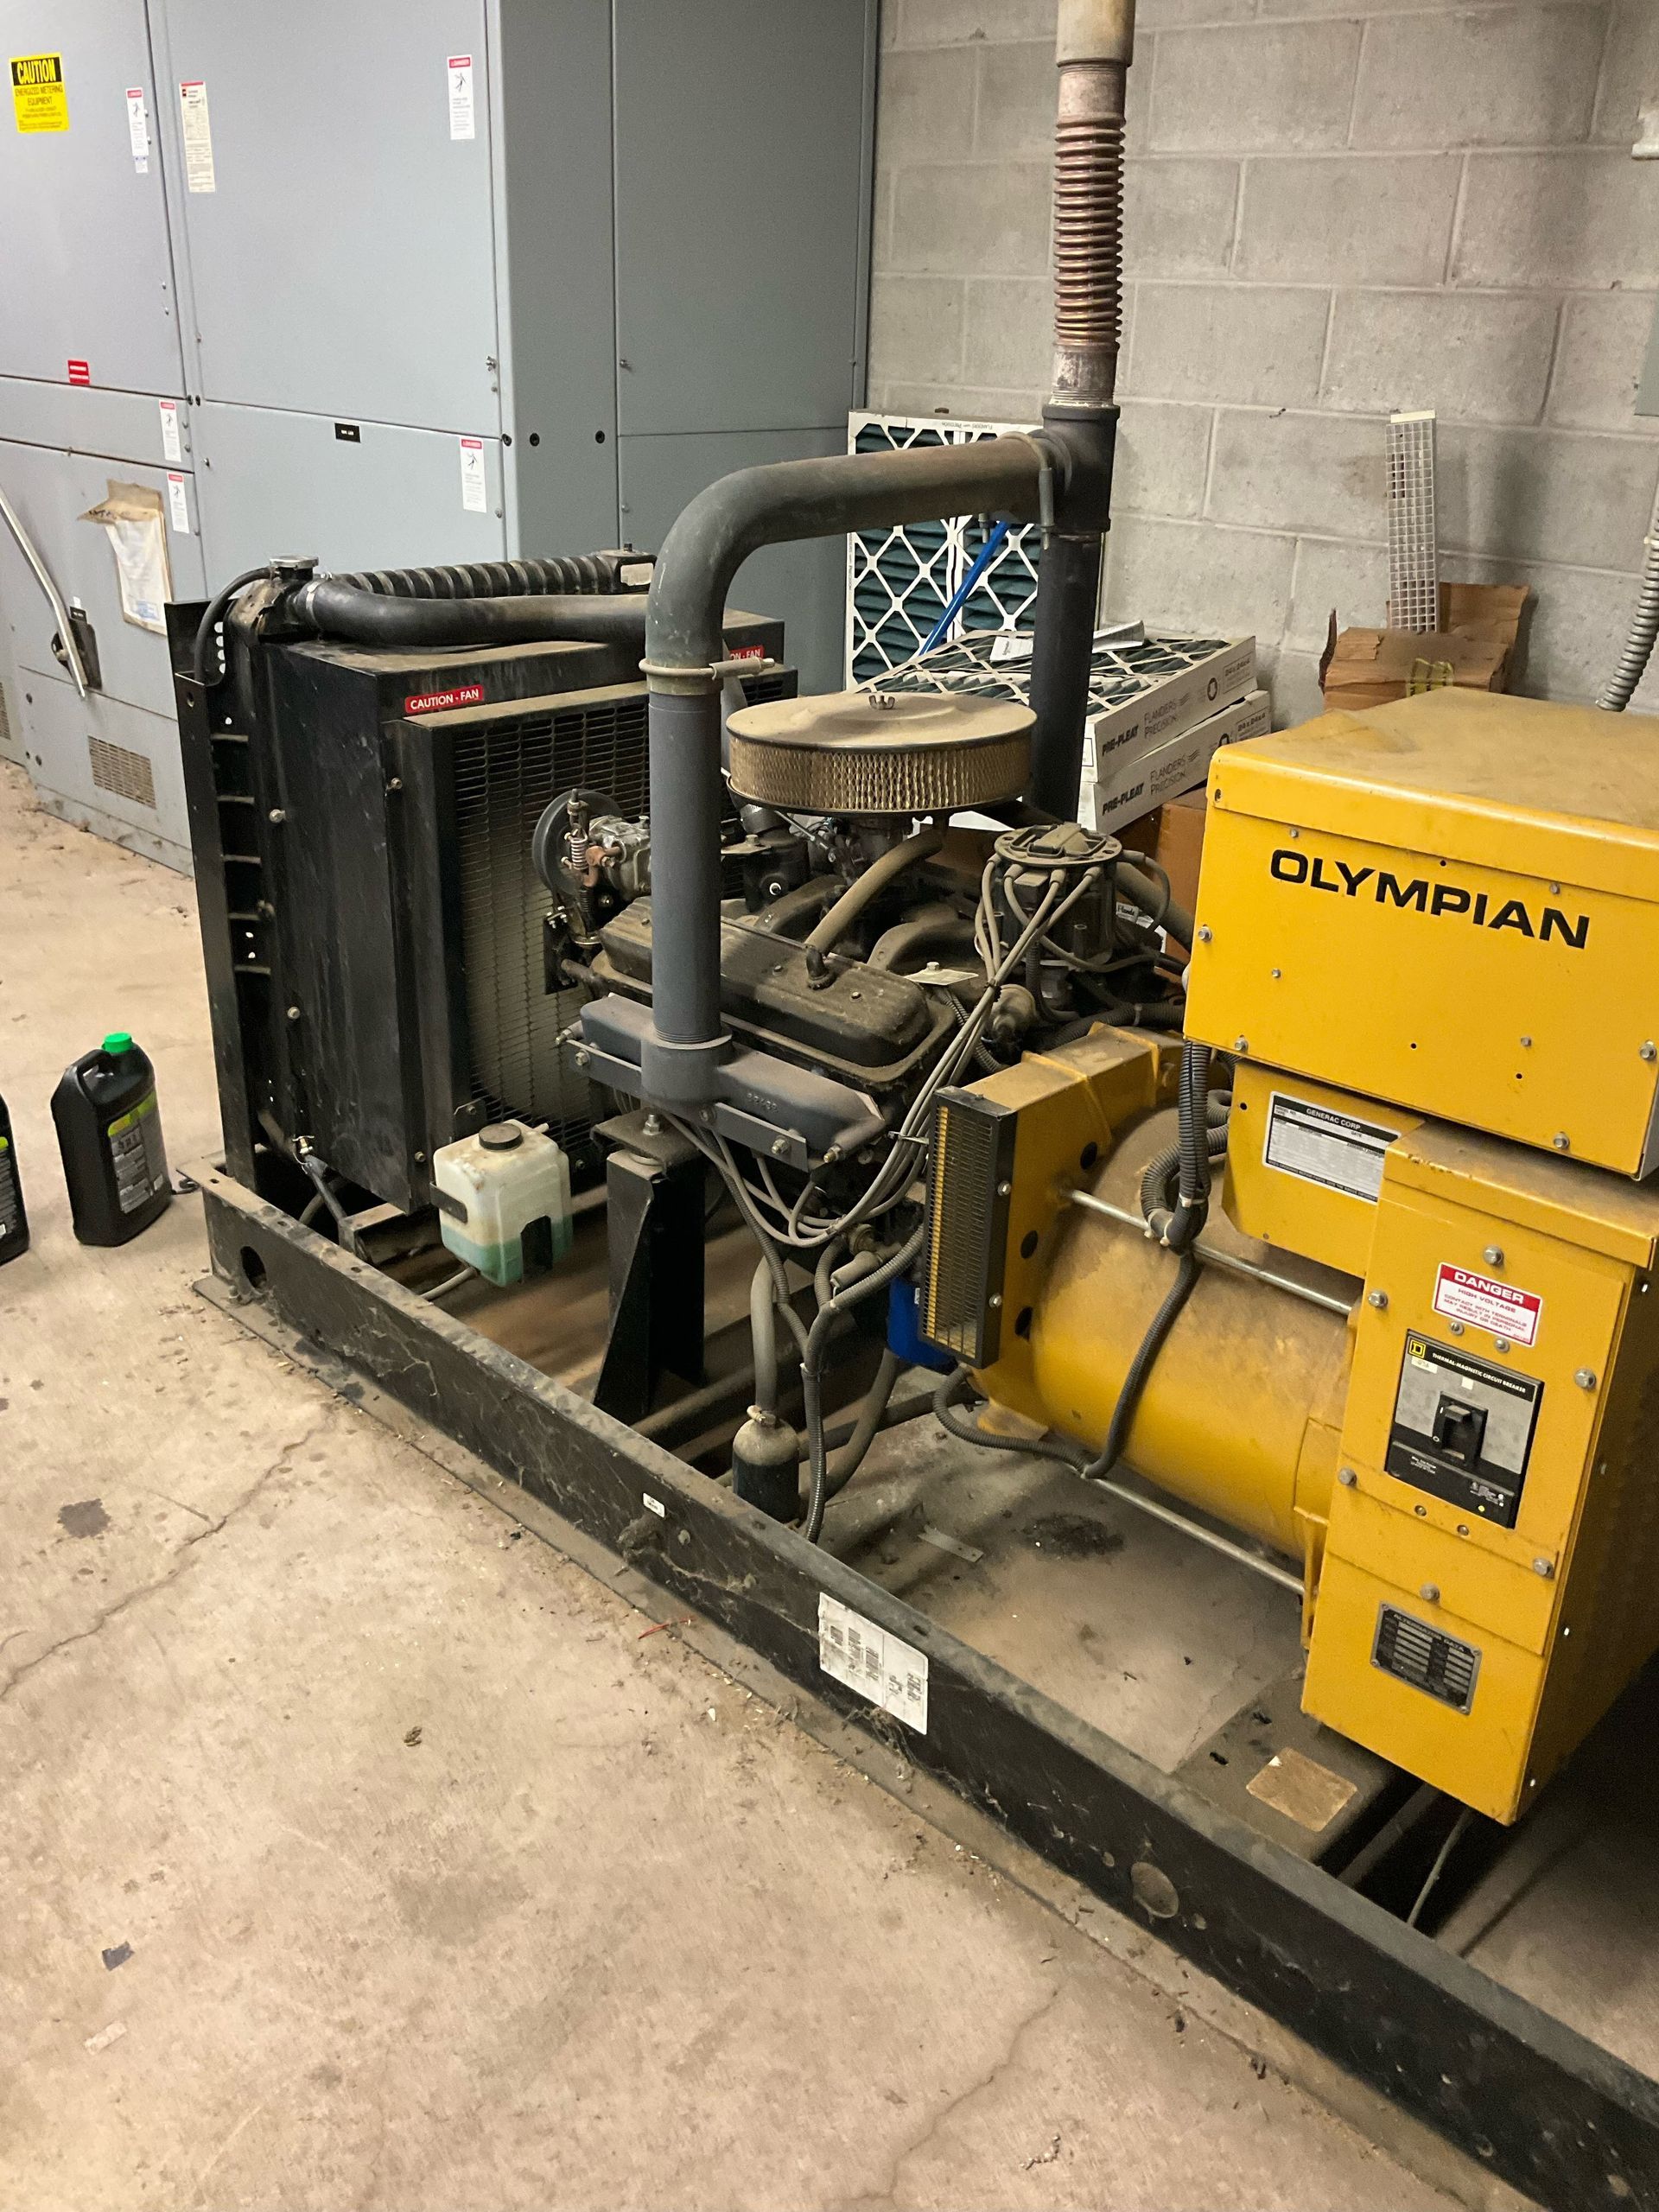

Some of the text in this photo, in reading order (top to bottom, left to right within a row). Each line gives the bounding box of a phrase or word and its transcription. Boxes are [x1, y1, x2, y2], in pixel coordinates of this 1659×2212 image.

[17, 59, 57, 85] CAUTION
[410, 694, 454, 709] CAUTION
[460, 689, 479, 701] FAN
[1144, 700, 1176, 723] FLANDERS
[1102, 724, 1139, 756] PRE-PLEAT
[1144, 715, 1177, 739] PRECISION
[1150, 753, 1186, 781] FLANDERS
[1150, 771, 1185, 795] PRECISION
[1102, 782, 1144, 816] PRE-PLEAT
[1271, 849, 1590, 950] OLYMPIAN
[1306, 1108, 1339, 1124] GENERAC
[1454, 1271, 1524, 1304] DANGER
[1458, 1288, 1516, 1313] HIGH VOLTAGE
[1445, 1294, 1472, 1306] CONTACT
[1491, 1311, 1528, 1327] TERMINALS
[1456, 1307, 1478, 1319] INJURY
[1491, 1320, 1511, 1332] DEATH
[1459, 1303, 1483, 1315] RESULT
[1492, 1316, 1525, 1332] PERSONAL
[1432, 1352, 1482, 1376] THERMAL-MAGNETIC
[1483, 1372, 1502, 1383] CIRCUIT
[1502, 1380, 1526, 1393] BREAKER
